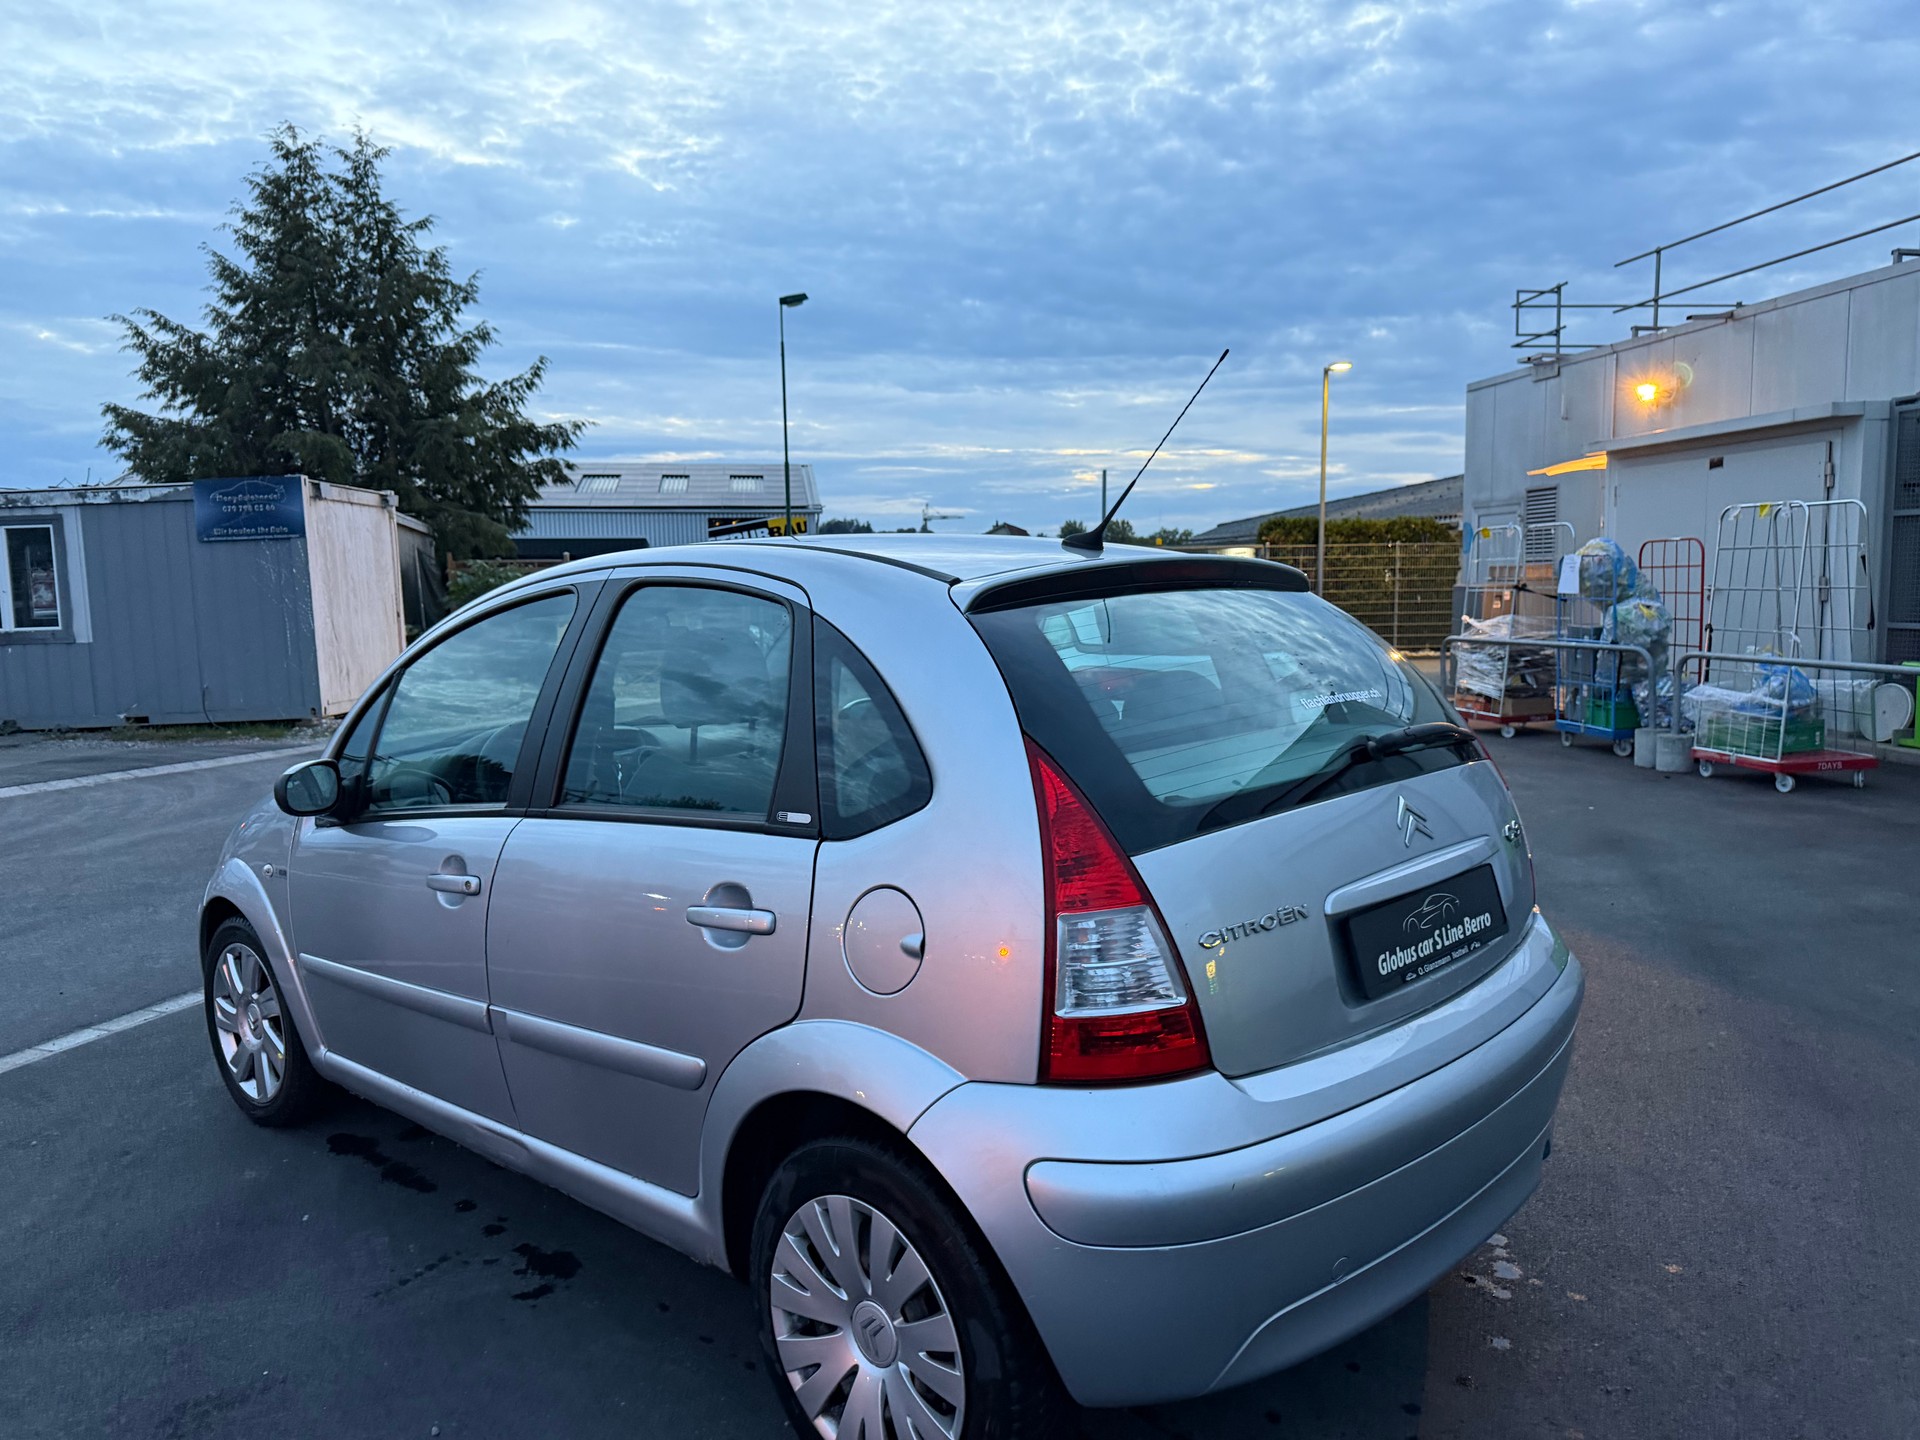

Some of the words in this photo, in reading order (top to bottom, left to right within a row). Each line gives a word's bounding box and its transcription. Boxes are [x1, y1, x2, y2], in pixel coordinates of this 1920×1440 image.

[1817, 761, 1843, 770] 7DAYS
[1198, 903, 1309, 949] CITROËN
[1378, 945, 1417, 975] Globus
[1418, 936, 1434, 957] car
[1434, 929, 1443, 951] S
[1442, 923, 1464, 946] Line
[1464, 912, 1491, 932] Berro
